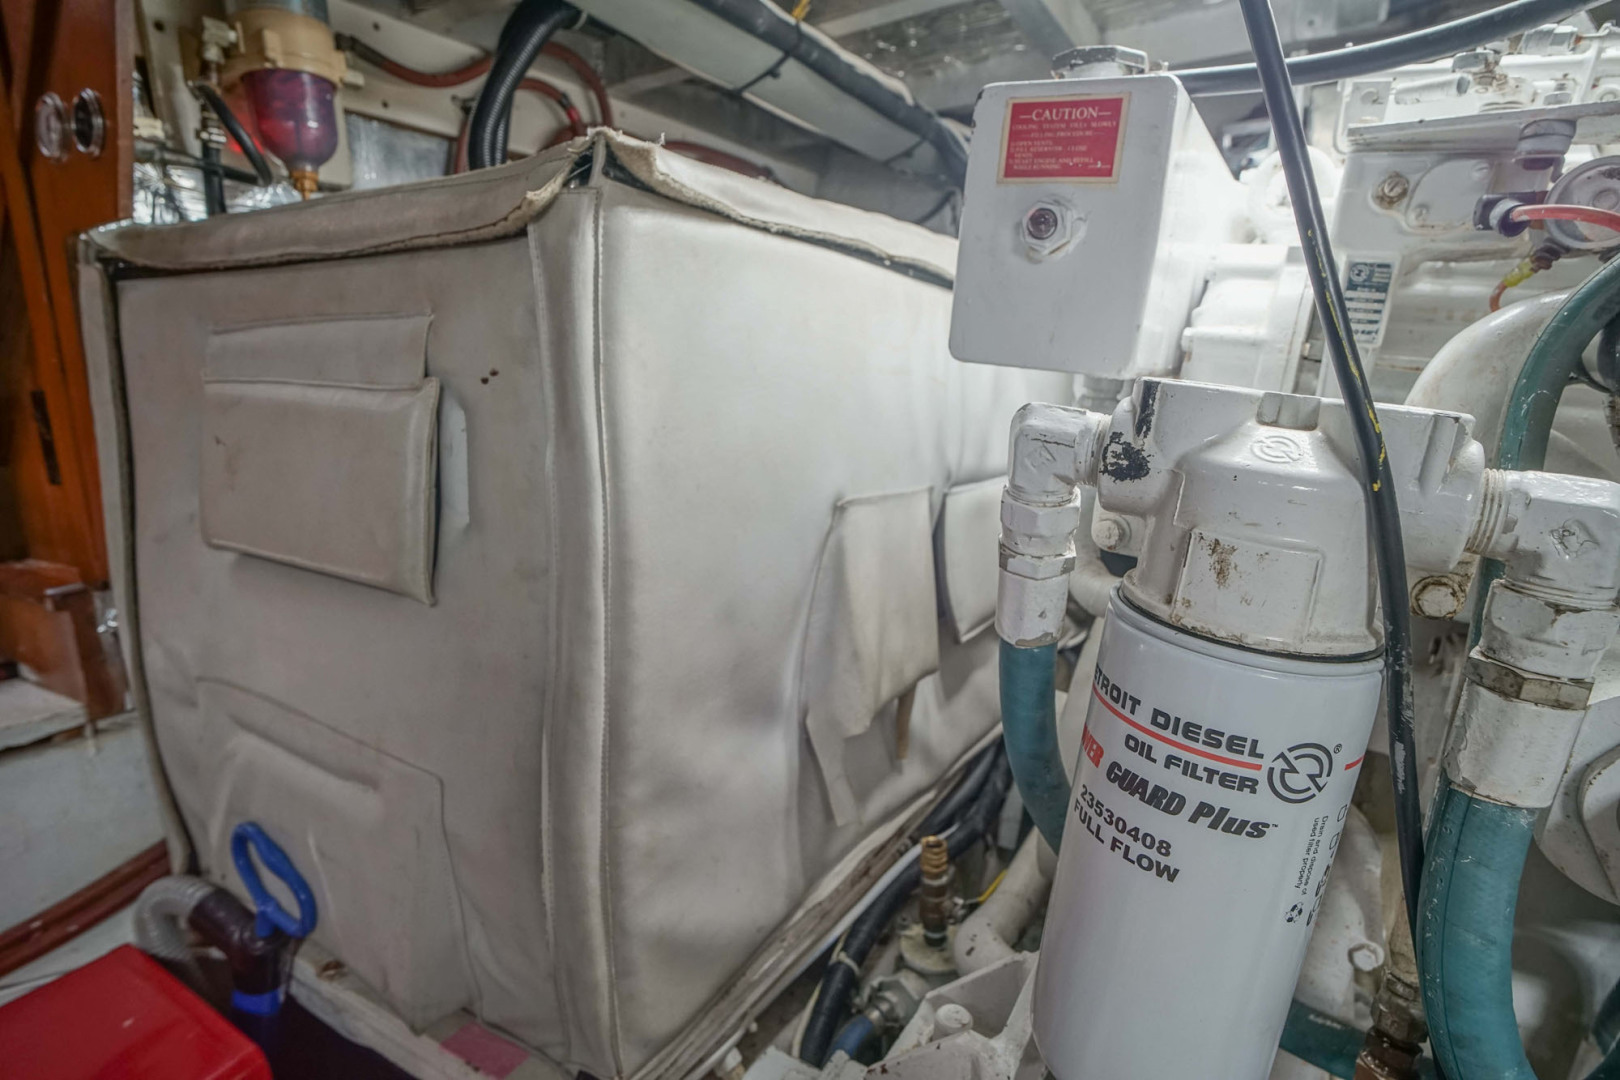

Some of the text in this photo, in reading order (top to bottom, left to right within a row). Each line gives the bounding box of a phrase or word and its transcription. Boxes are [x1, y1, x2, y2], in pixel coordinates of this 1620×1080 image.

[1124, 733, 1260, 795] OIL FILTER
[1150, 707, 1265, 759] DIESEL
[1106, 761, 1187, 816] GUARD
[1074, 797, 1180, 883] FULL FLOW
[1080, 784, 1172, 858] 23530408
